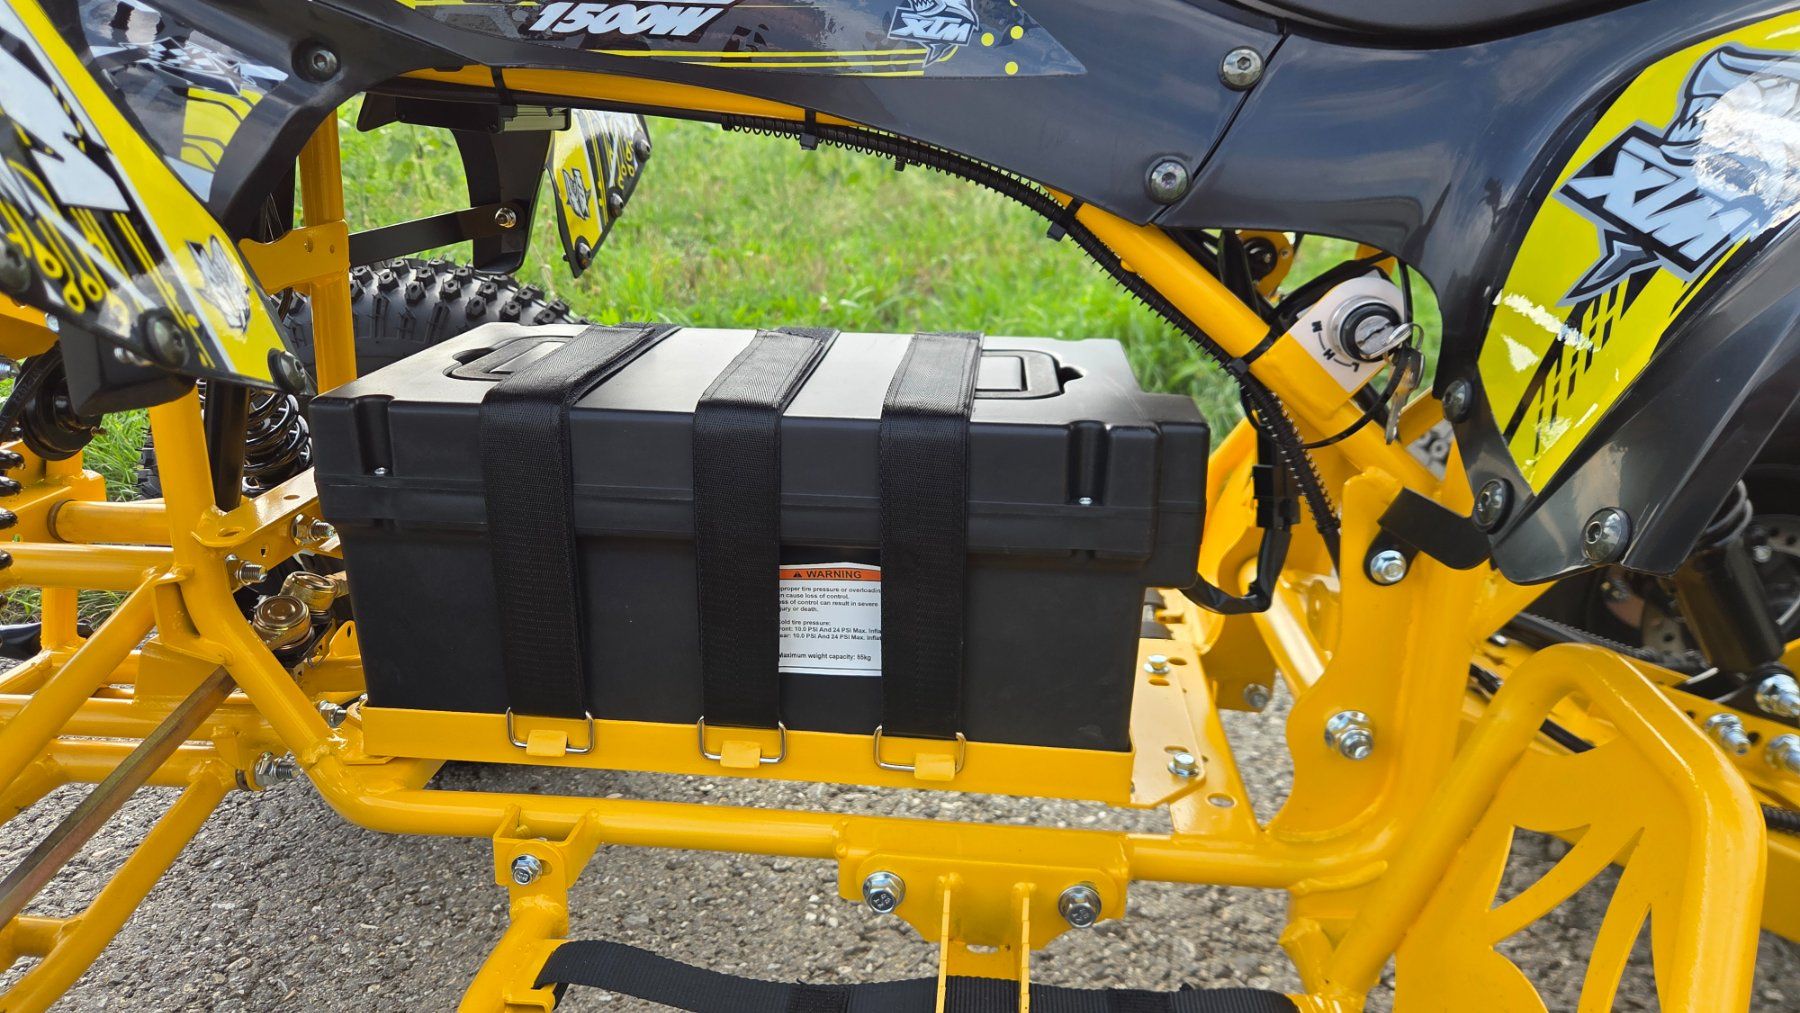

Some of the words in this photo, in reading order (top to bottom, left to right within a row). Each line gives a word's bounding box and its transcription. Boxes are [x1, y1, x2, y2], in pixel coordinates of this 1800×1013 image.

[528, 2, 725, 37] 1500W
[890, 12, 972, 42] XTM
[1566, 136, 1753, 262] XTM
[806, 570, 862, 578] WARNING
[807, 652, 828, 660] weight
